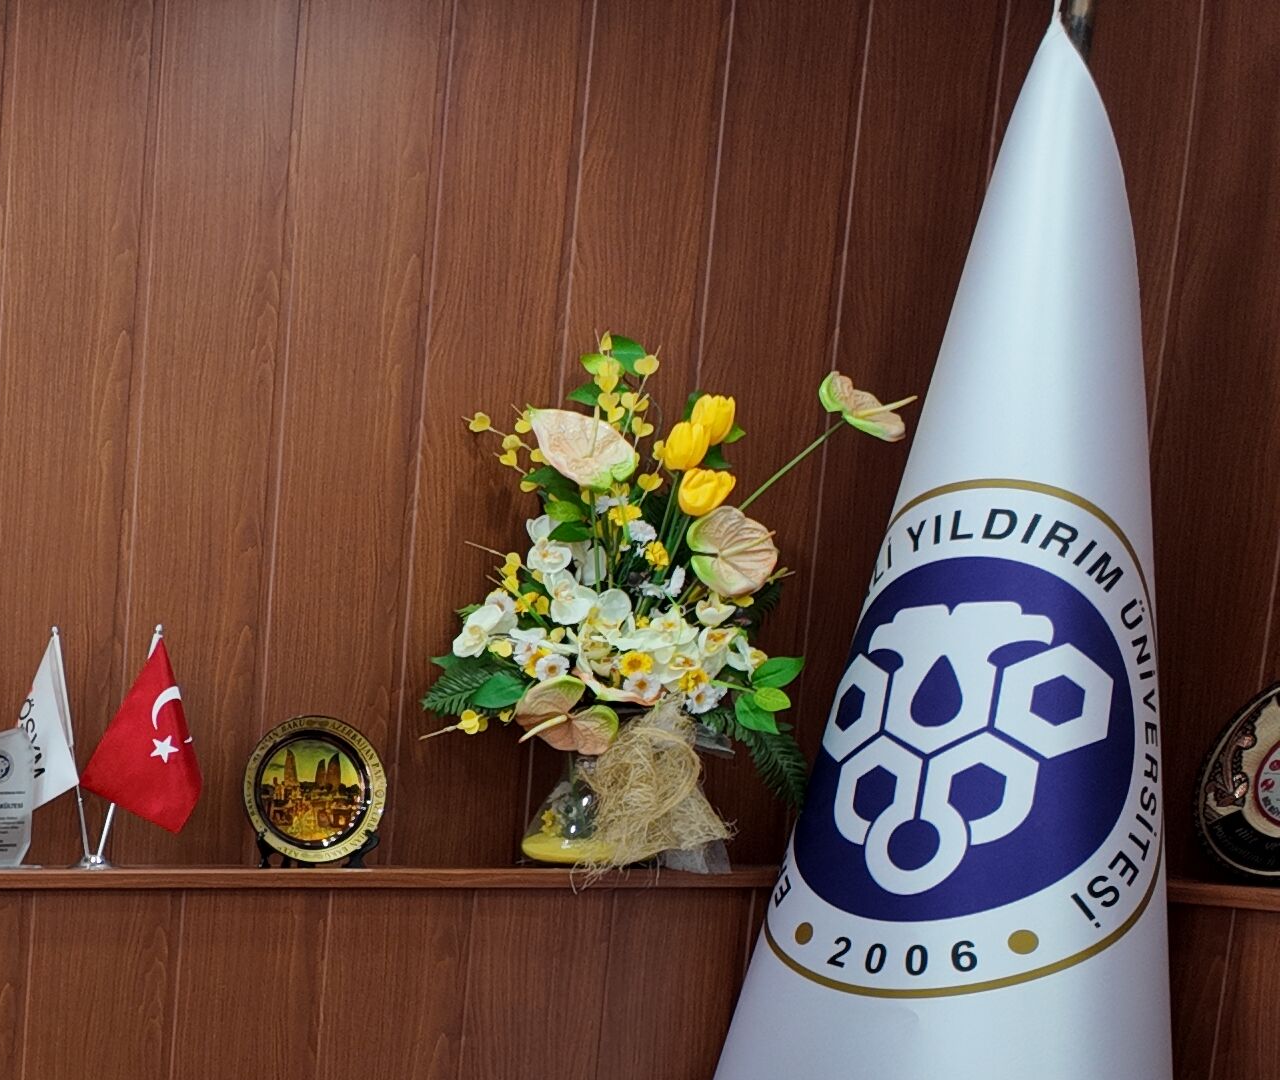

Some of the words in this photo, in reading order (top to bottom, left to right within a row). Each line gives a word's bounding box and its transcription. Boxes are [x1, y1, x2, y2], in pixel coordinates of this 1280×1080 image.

[906, 507, 1124, 593] YILDIRIM
[1070, 599, 1160, 929] ÜNİVERSİTESİ
[827, 935, 979, 977] 2006
